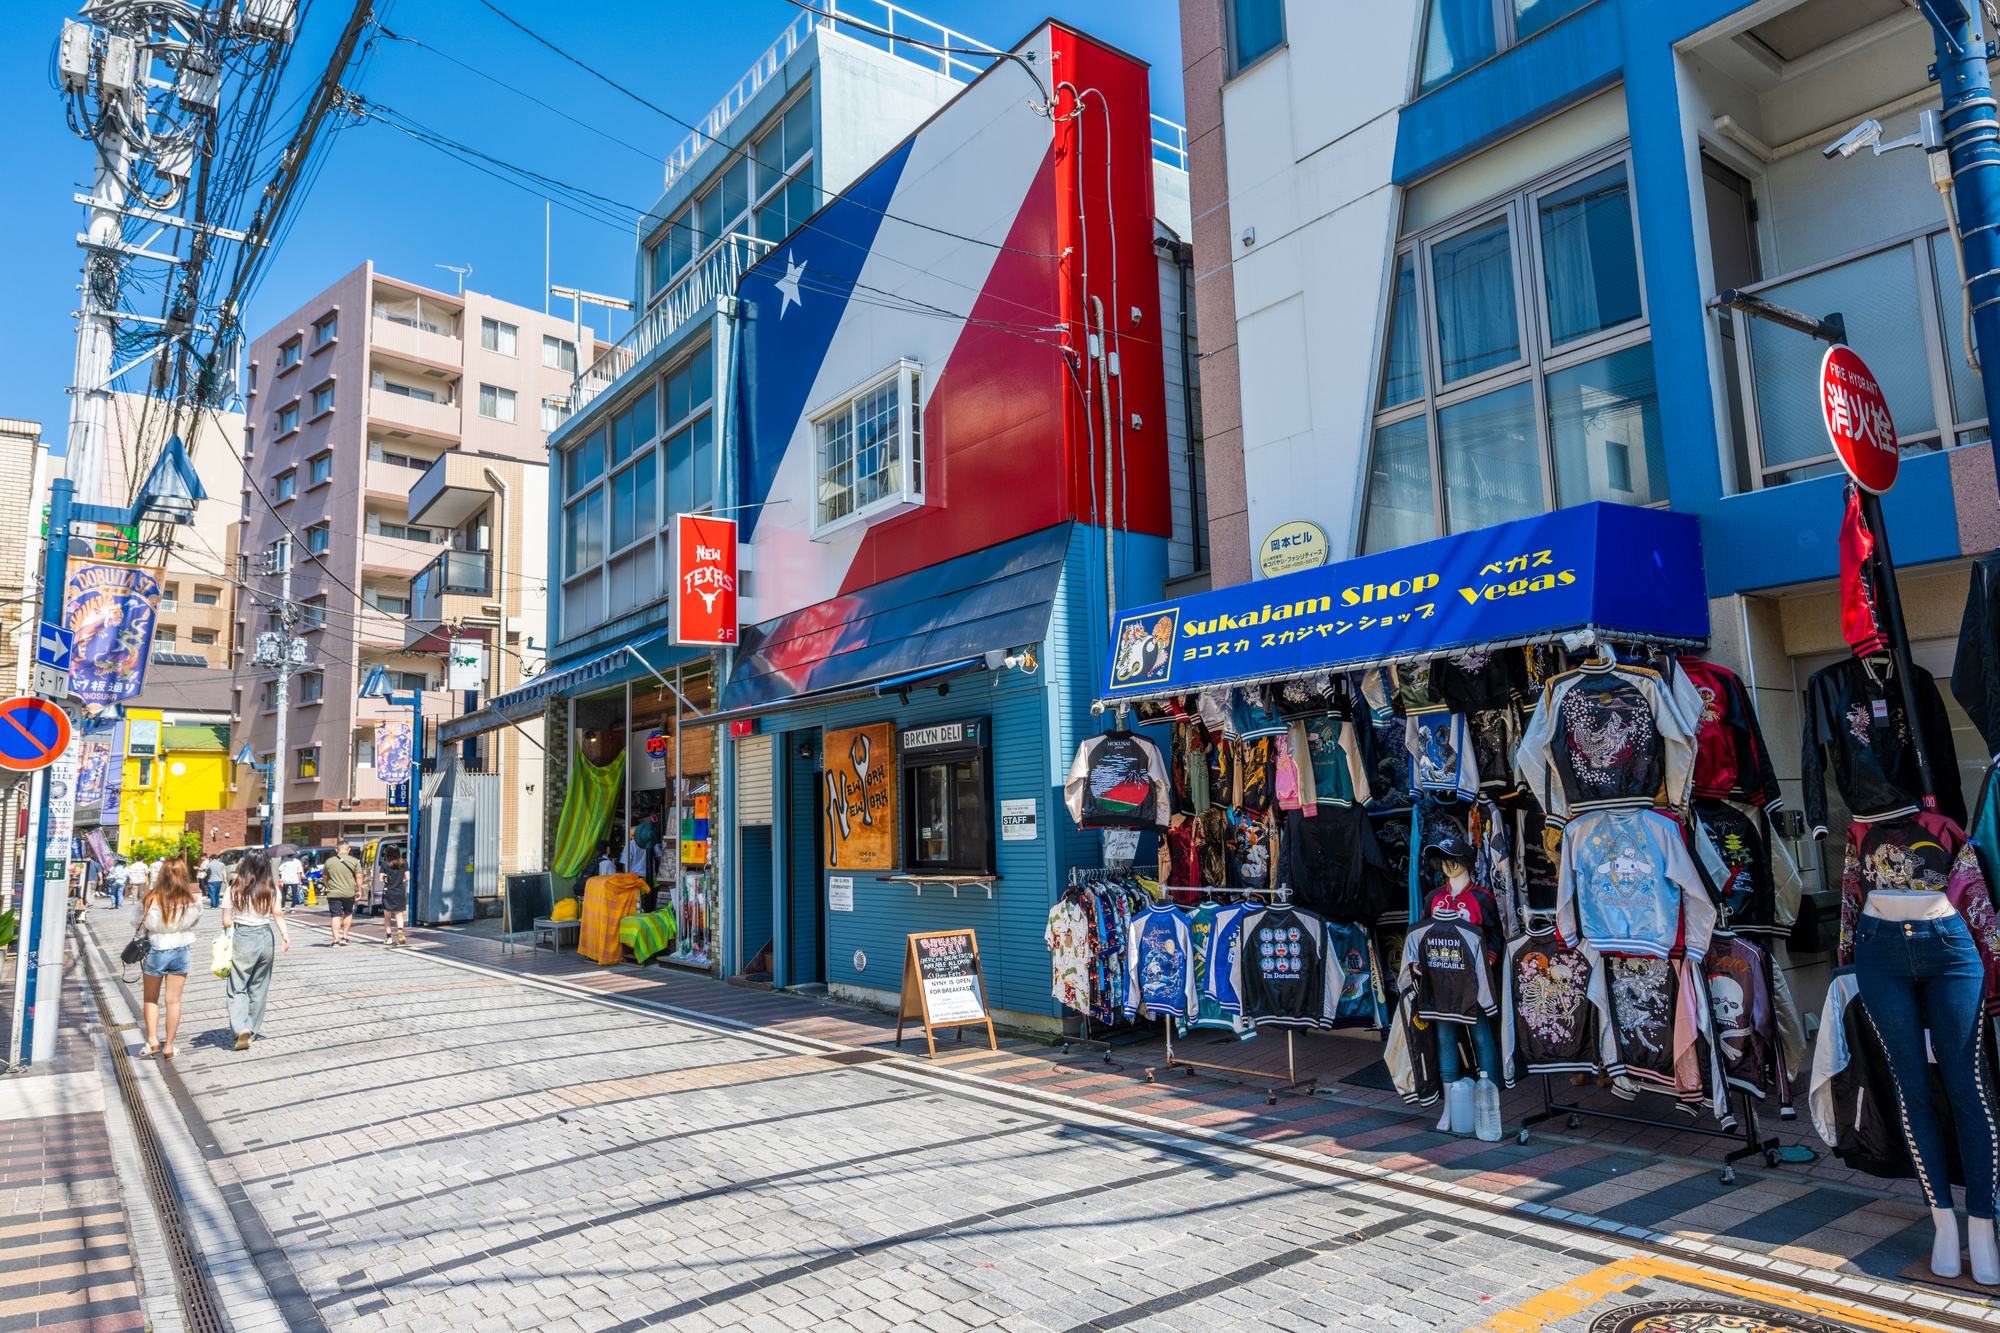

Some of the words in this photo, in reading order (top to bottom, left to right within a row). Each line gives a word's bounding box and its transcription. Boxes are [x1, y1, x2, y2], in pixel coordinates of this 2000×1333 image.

[1829, 361, 1847, 381] FIRE
[1848, 370, 1878, 396] HYDRANT
[1826, 381, 1897, 455] 消火栓
[1270, 531, 1313, 552] 岡本ビル
[696, 545, 721, 562] NEW
[1479, 549, 1554, 576] ベガス
[76, 568, 135, 590] DOBUITA
[134, 576, 156, 595] ST
[683, 566, 734, 595] TEXAS
[1458, 569, 1576, 605] Vegas
[1182, 596, 1331, 638] Sukajam
[1340, 573, 1440, 608] Shop
[717, 628, 734, 639] 2F
[1183, 638, 1250, 662] ヨコスカ
[72, 679, 135, 694] ドブ板通り
[905, 728, 937, 746] BRKLYN
[941, 725, 960, 741] DELI
[1003, 816, 1027, 825] STAFF
[920, 935, 966, 949] BRKLYN
[1427, 938, 1460, 947] MINION
